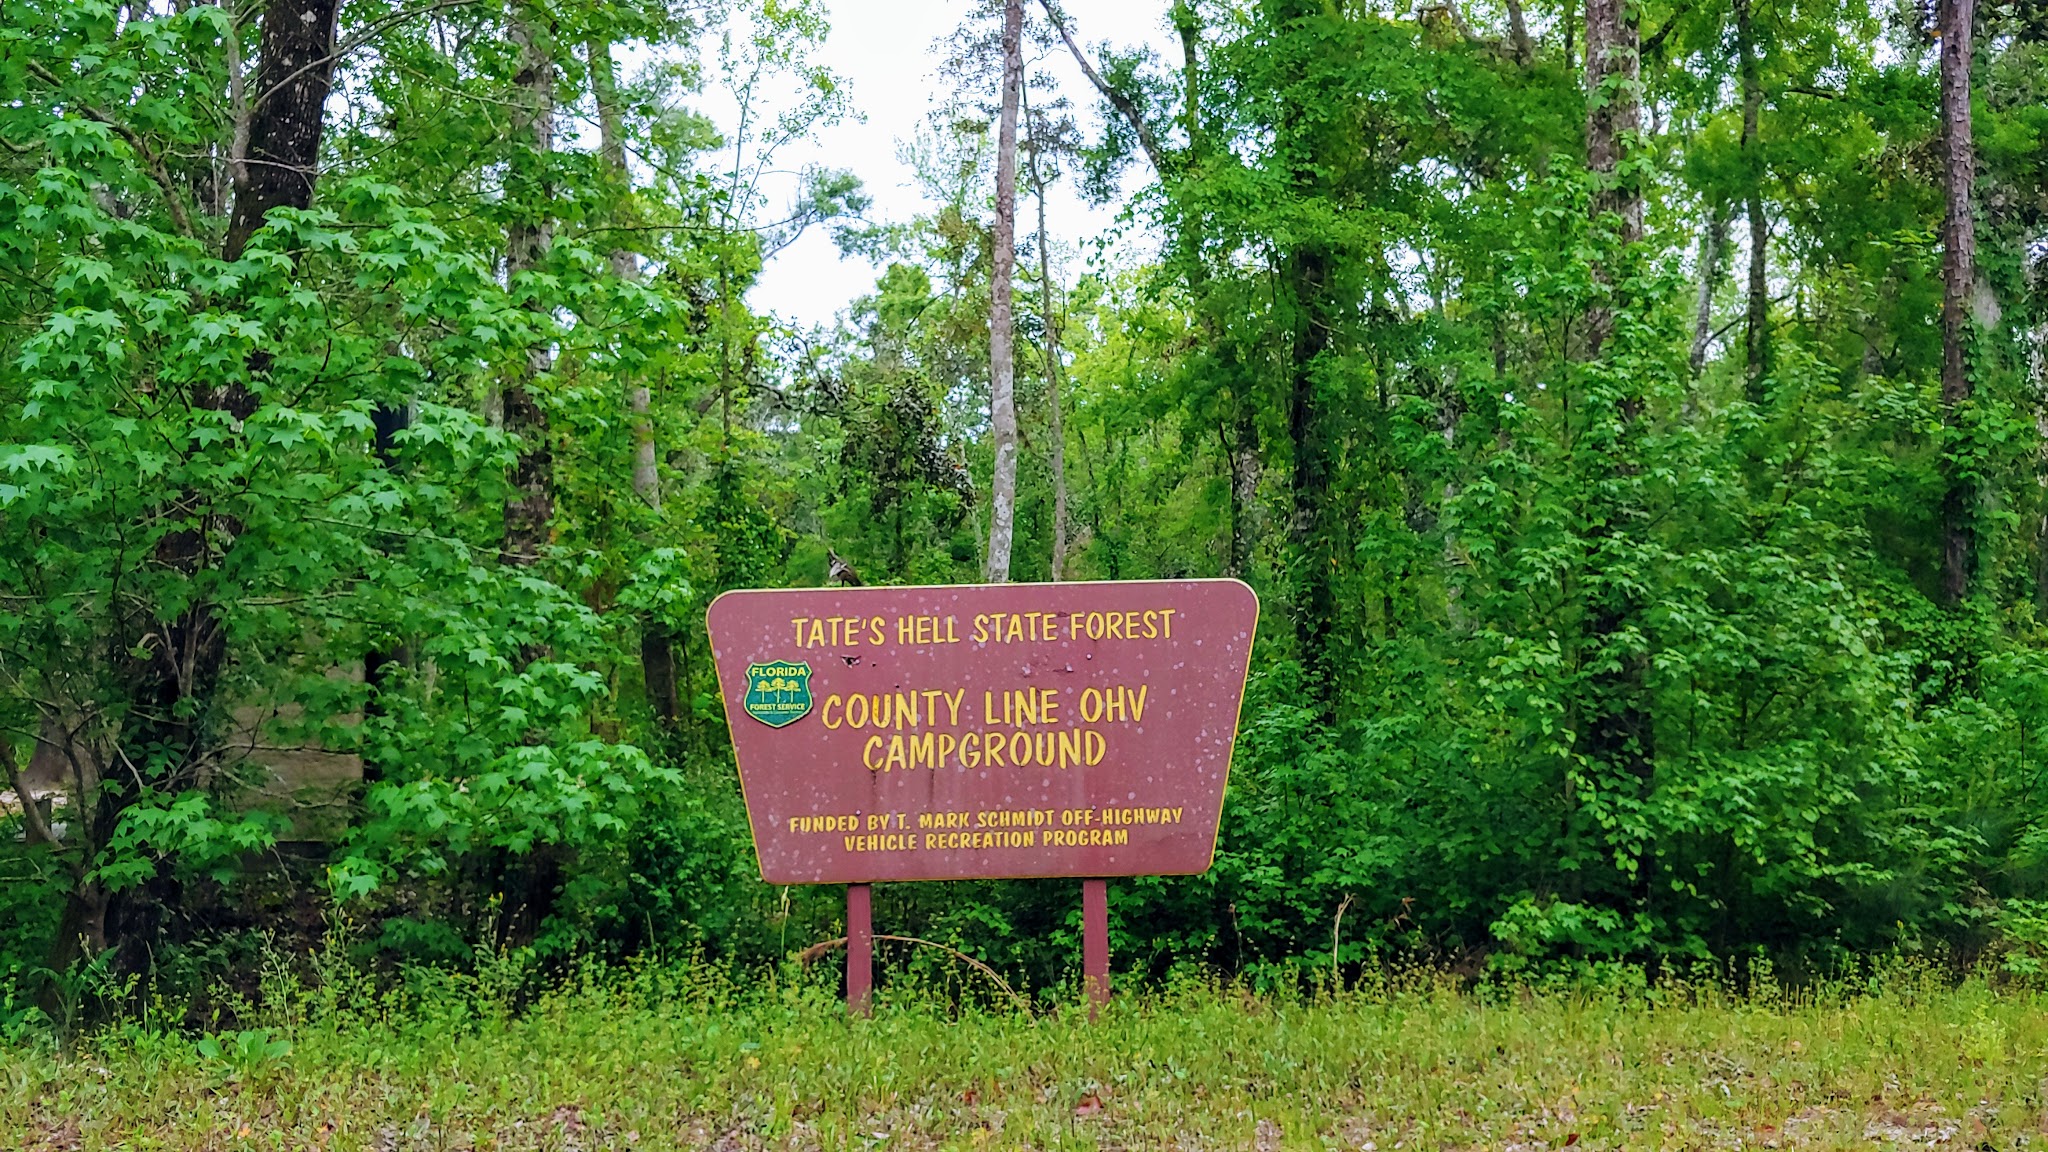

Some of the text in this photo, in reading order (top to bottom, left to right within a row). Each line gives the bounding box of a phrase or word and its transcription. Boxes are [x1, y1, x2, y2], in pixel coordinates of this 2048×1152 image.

[792, 608, 1175, 647] TATE'S HELL STATE FOREST
[752, 667, 806, 677] FLORIDA
[750, 703, 806, 711] FOREST SERVICE
[822, 685, 1147, 729] COUNTY LINE OHV
[863, 728, 1106, 771] CAMPGROUND
[790, 807, 1182, 832] FUNDED BY T. MARK SCHMIDT OFF-HIGHWAY
[844, 828, 1128, 851] VEHICLE RECREATION PROGRAM
